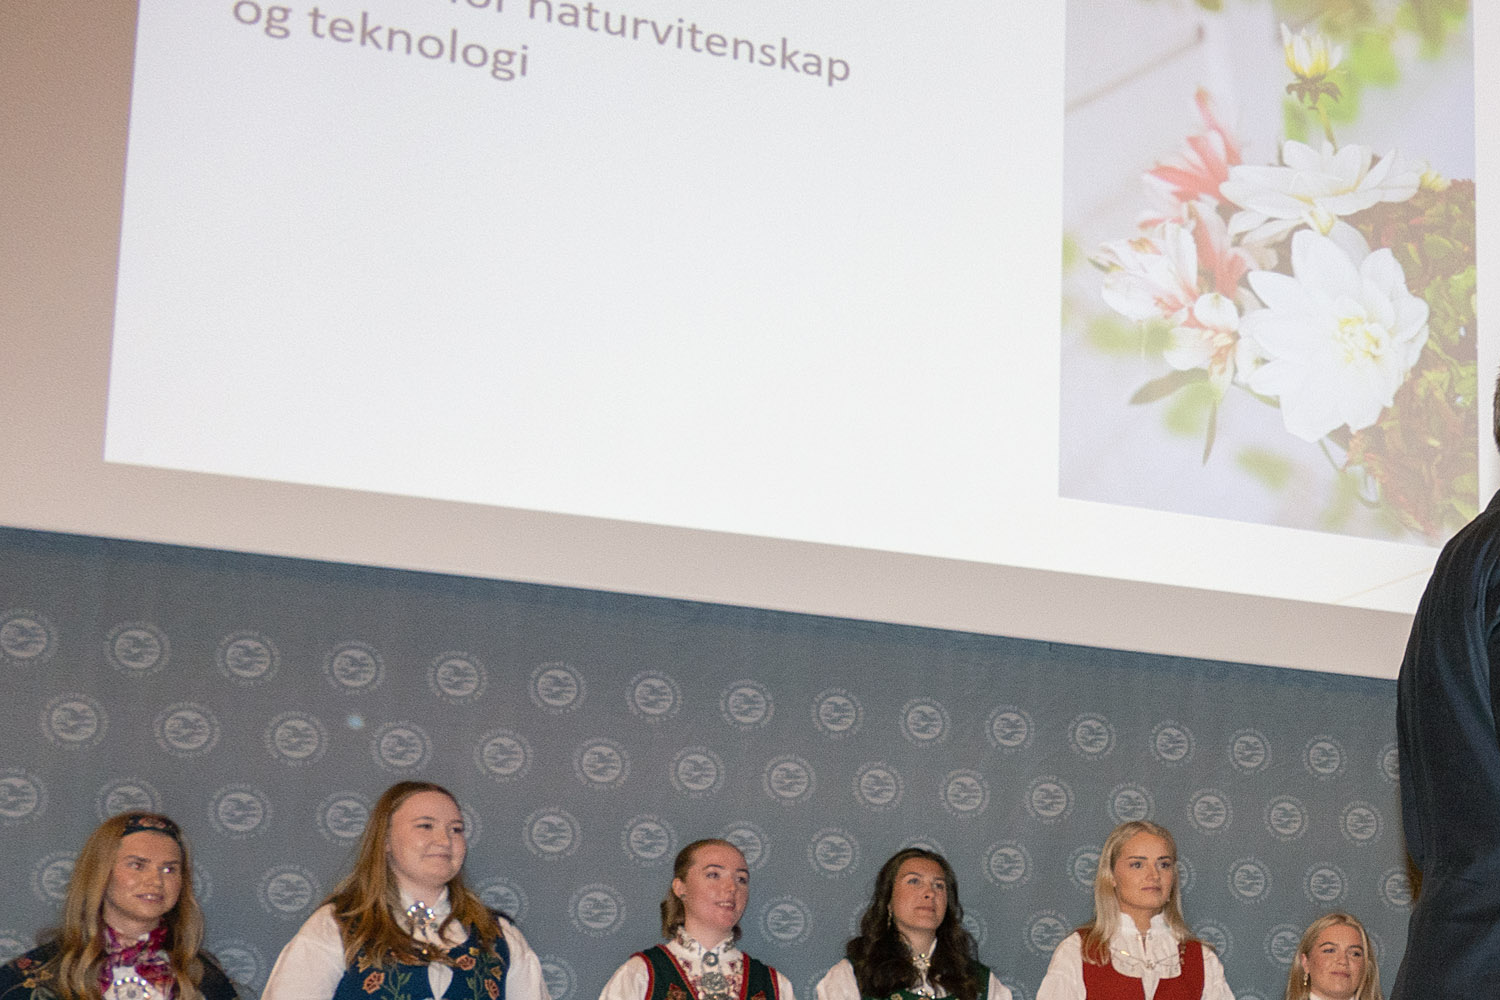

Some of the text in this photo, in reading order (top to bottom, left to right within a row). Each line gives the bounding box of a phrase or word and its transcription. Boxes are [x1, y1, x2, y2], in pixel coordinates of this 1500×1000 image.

[233, 0, 528, 82] og teknologi
[528, 0, 851, 87] naturvitenskap
